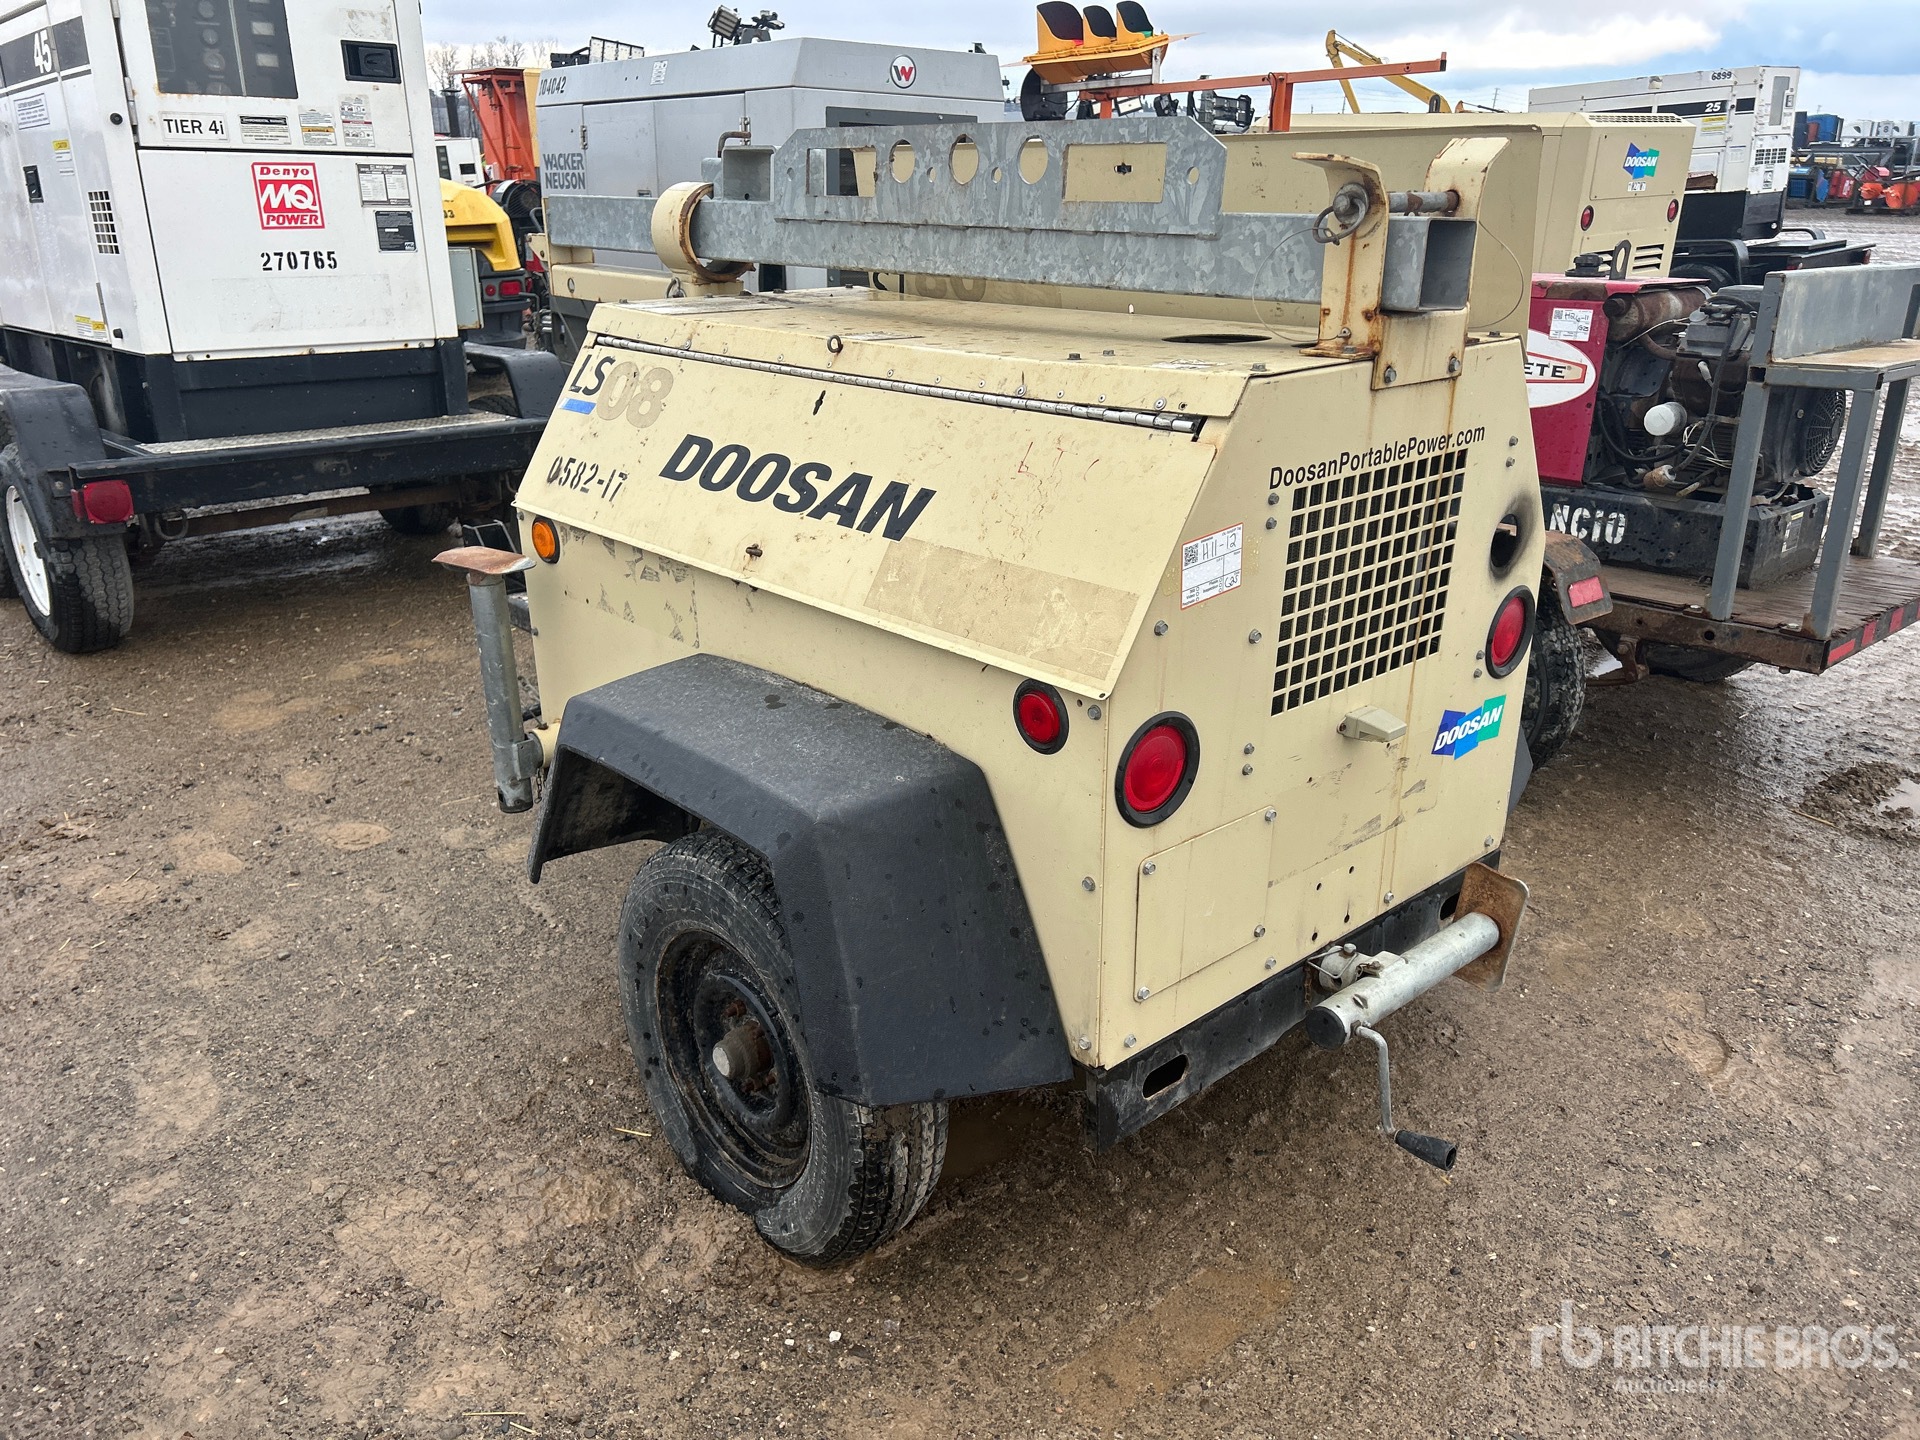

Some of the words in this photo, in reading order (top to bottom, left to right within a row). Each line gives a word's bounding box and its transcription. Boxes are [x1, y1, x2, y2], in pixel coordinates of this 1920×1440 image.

[33, 29, 53, 74] 45
[1711, 71, 1732, 81] 6899
[1705, 102, 1722, 113] 25
[163, 118, 203, 135] TIER
[208, 119, 225, 136] 4i
[543, 152, 585, 171] WACKER
[1625, 156, 1658, 167] DOOSAN
[259, 166, 310, 178] Denyo
[545, 172, 586, 190] NEUSON
[261, 183, 318, 211] MQ
[266, 214, 319, 226] POWER
[260, 250, 338, 271] 270765
[1524, 362, 1567, 379] ETE
[568, 354, 674, 429] LS08
[1269, 425, 1486, 490] DoosanPortablePower.com
[546, 455, 630, 503] 0582-17
[659, 433, 937, 541] DOOSAN
[1549, 503, 1627, 545] NC10
[1433, 703, 1504, 753] DOOSAN
